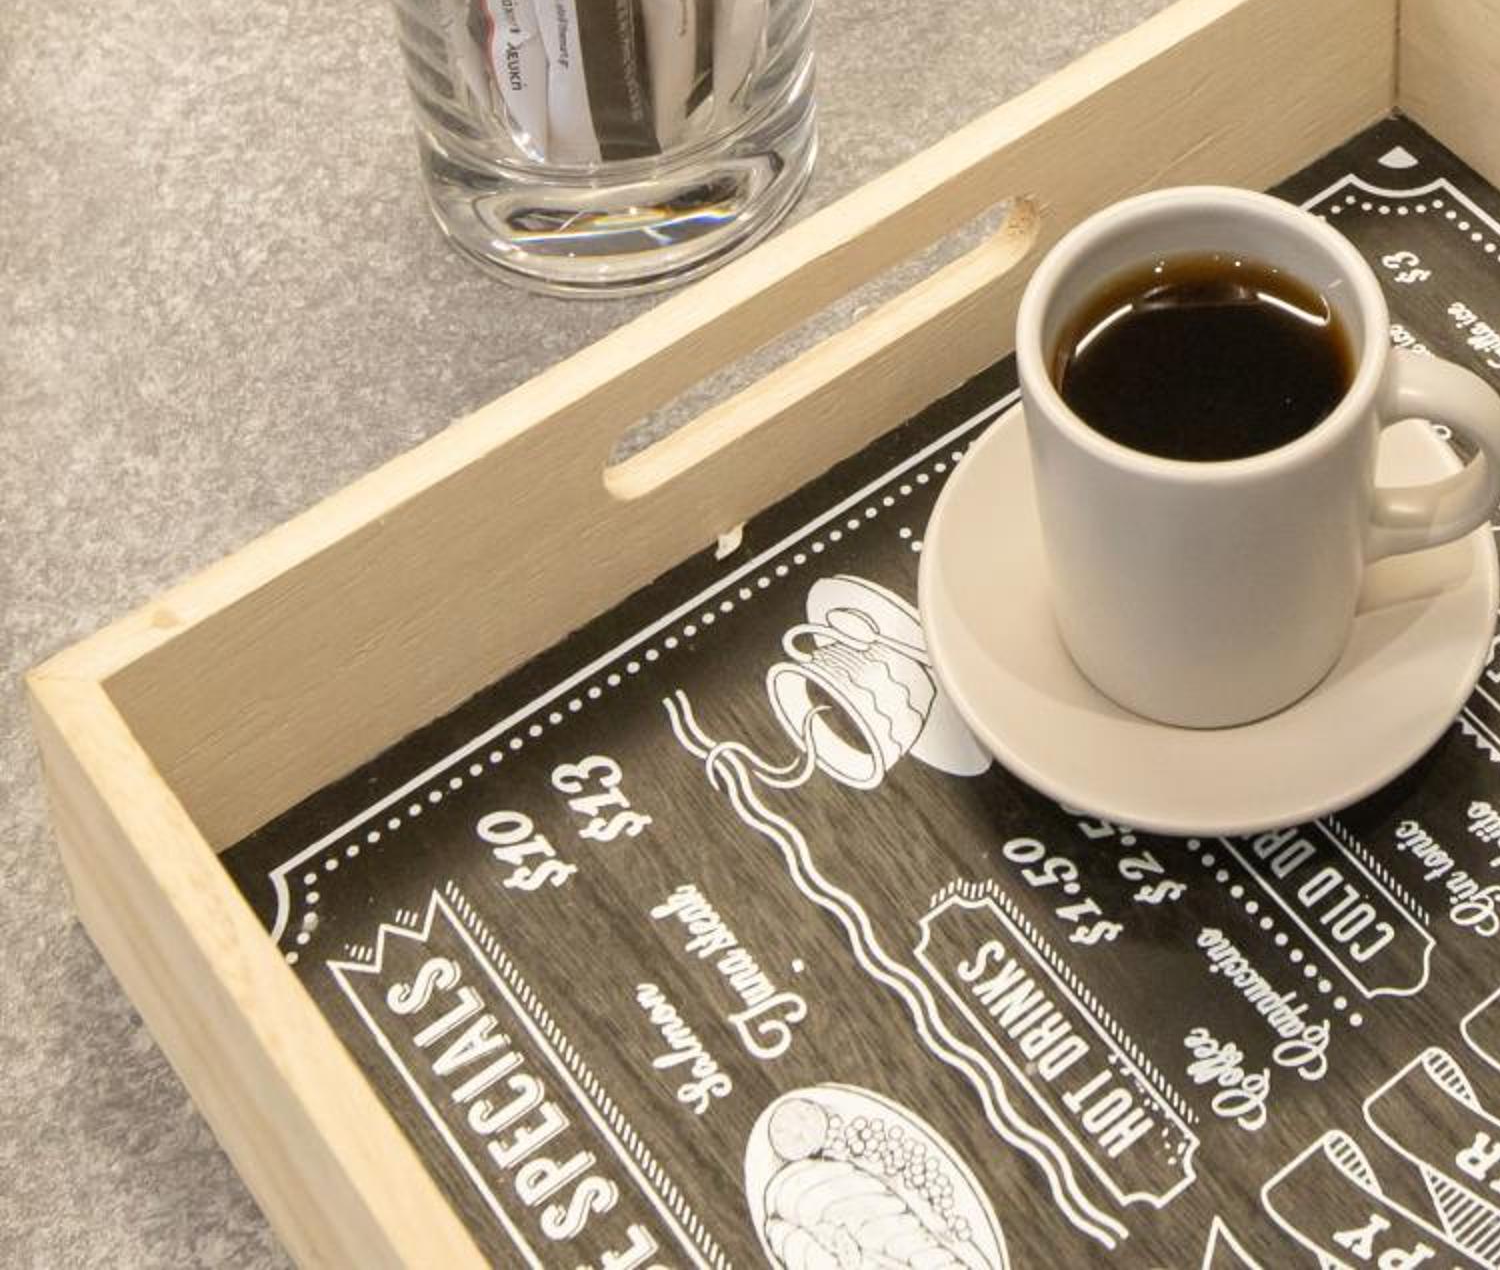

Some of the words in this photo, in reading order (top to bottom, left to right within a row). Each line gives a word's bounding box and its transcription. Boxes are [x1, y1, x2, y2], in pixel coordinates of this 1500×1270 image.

[1382, 251, 1431, 283] $3
[551, 755, 652, 842] $13
[477, 810, 578, 891] $10
[1002, 837, 1124, 945] $1.50
[1395, 819, 1455, 881] tonic
[651, 883, 738, 958] steak
[1298, 866, 1395, 963] COLD
[635, 982, 733, 1115] Salmon
[715, 947, 807, 1060] Tuna
[957, 939, 1090, 1081] DRINKS
[1197, 927, 1330, 1081] Cappuccino
[386, 956, 620, 1240] SPECIALS
[1062, 1071, 1155, 1158] HOT
[1183, 1026, 1271, 1130] Coffee
